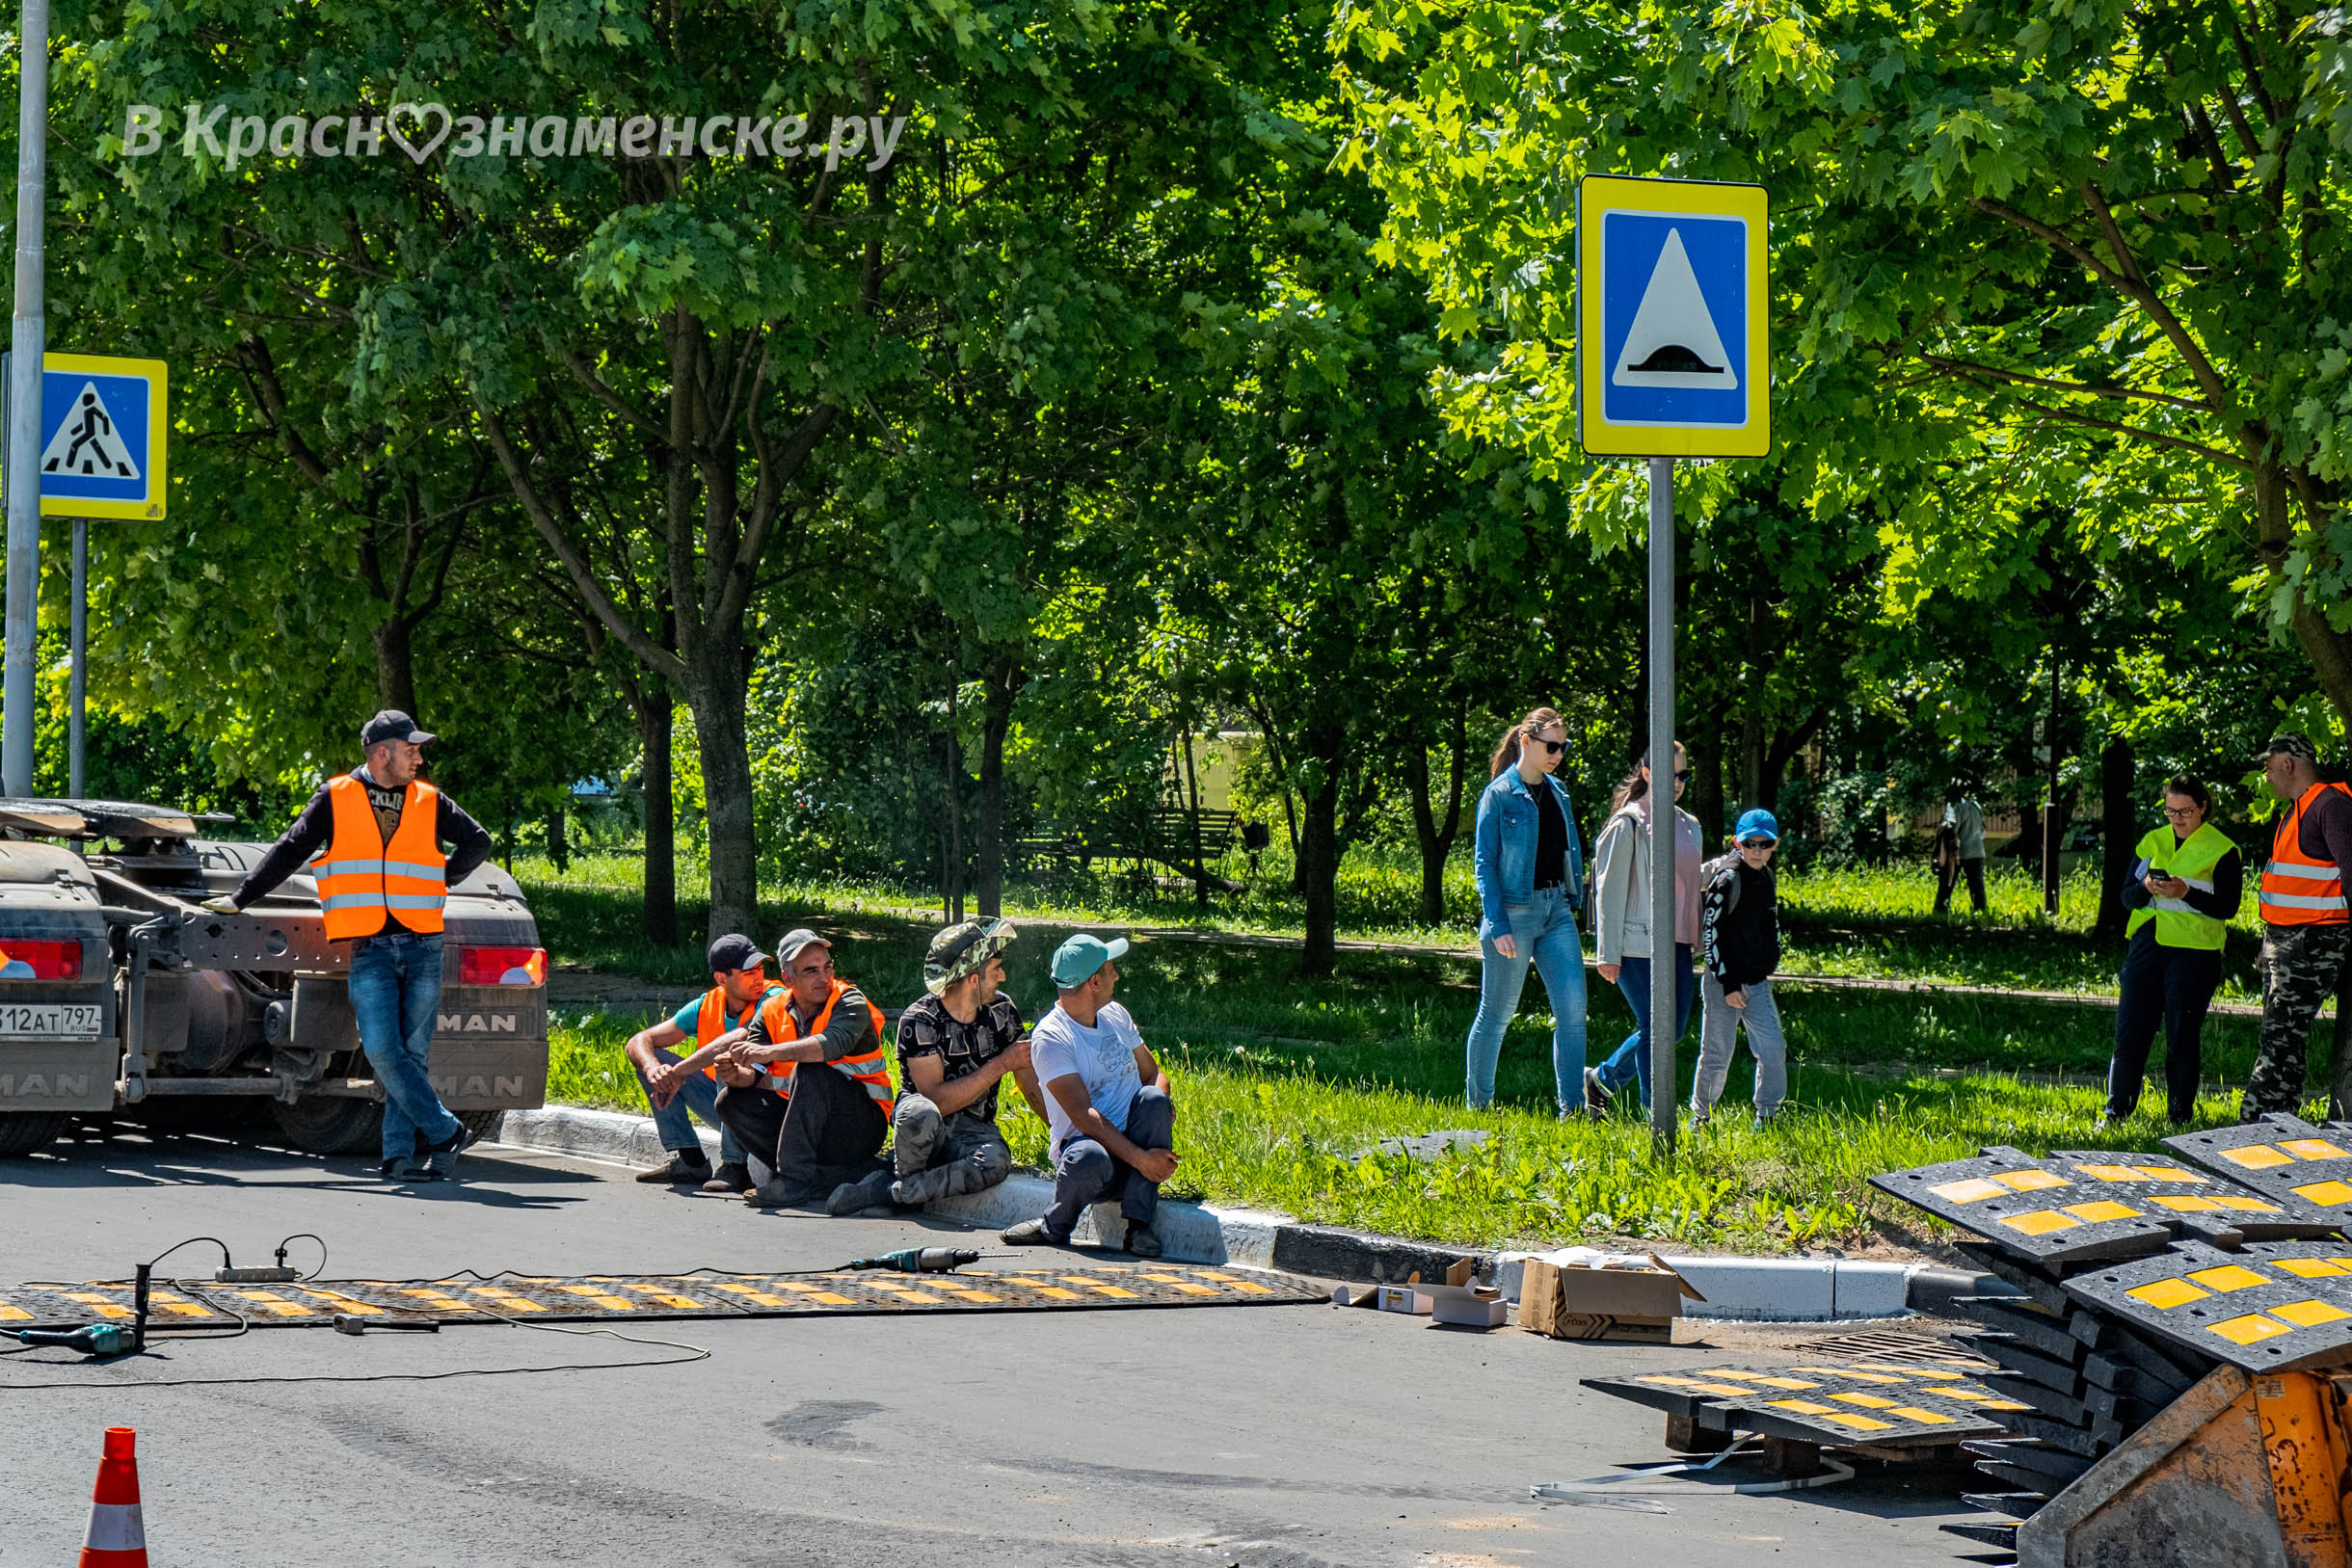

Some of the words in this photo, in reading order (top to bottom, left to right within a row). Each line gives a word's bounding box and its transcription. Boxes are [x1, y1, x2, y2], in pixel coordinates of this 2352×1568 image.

[0, 1008, 59, 1031] 12AT
[64, 1007, 94, 1024] 797
[69, 1024, 87, 1033] RUS
[436, 1014, 517, 1032] MAN
[428, 1075, 524, 1098] MAN
